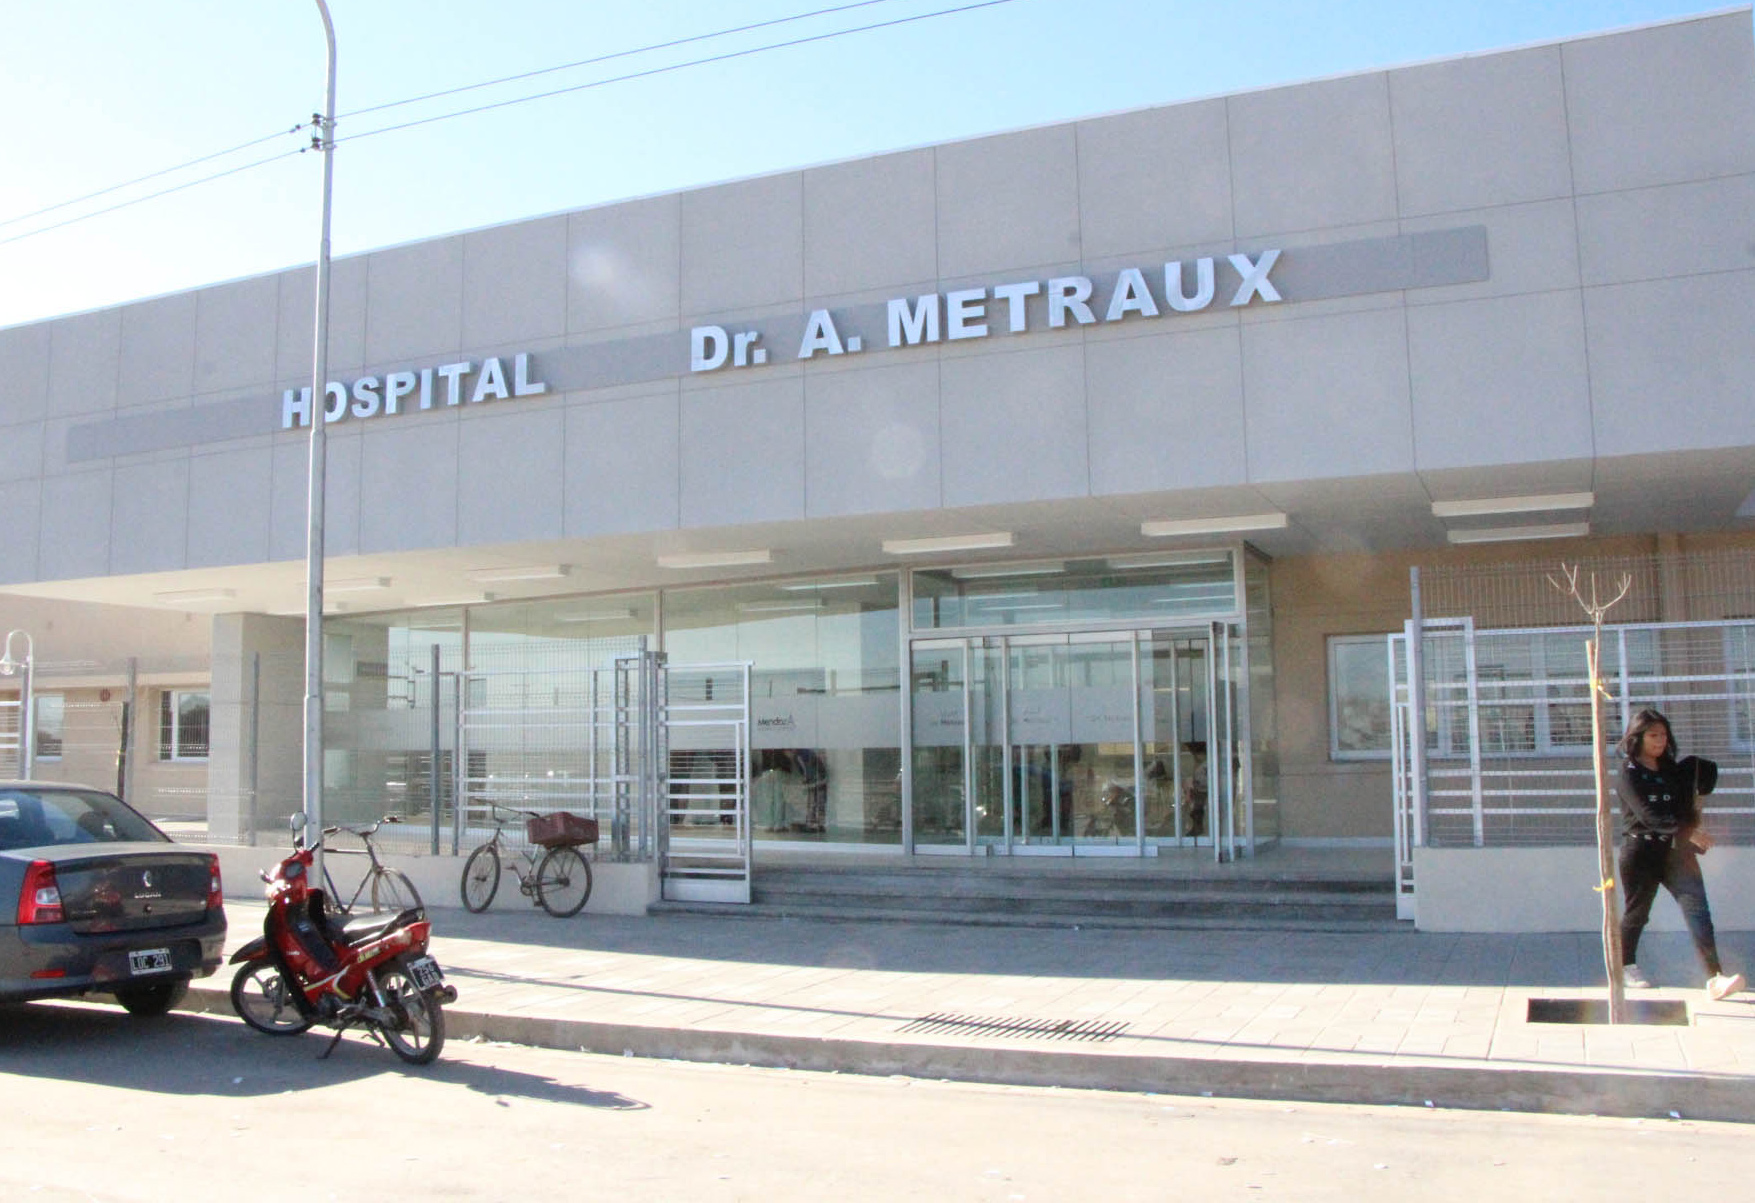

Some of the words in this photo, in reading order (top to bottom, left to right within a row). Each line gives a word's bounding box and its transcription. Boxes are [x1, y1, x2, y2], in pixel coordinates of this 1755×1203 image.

[281, 353, 546, 429] HOSPITAL
[690, 325, 767, 372] Dr.
[797, 309, 862, 358] A.
[887, 248, 1284, 347] METRAUX
